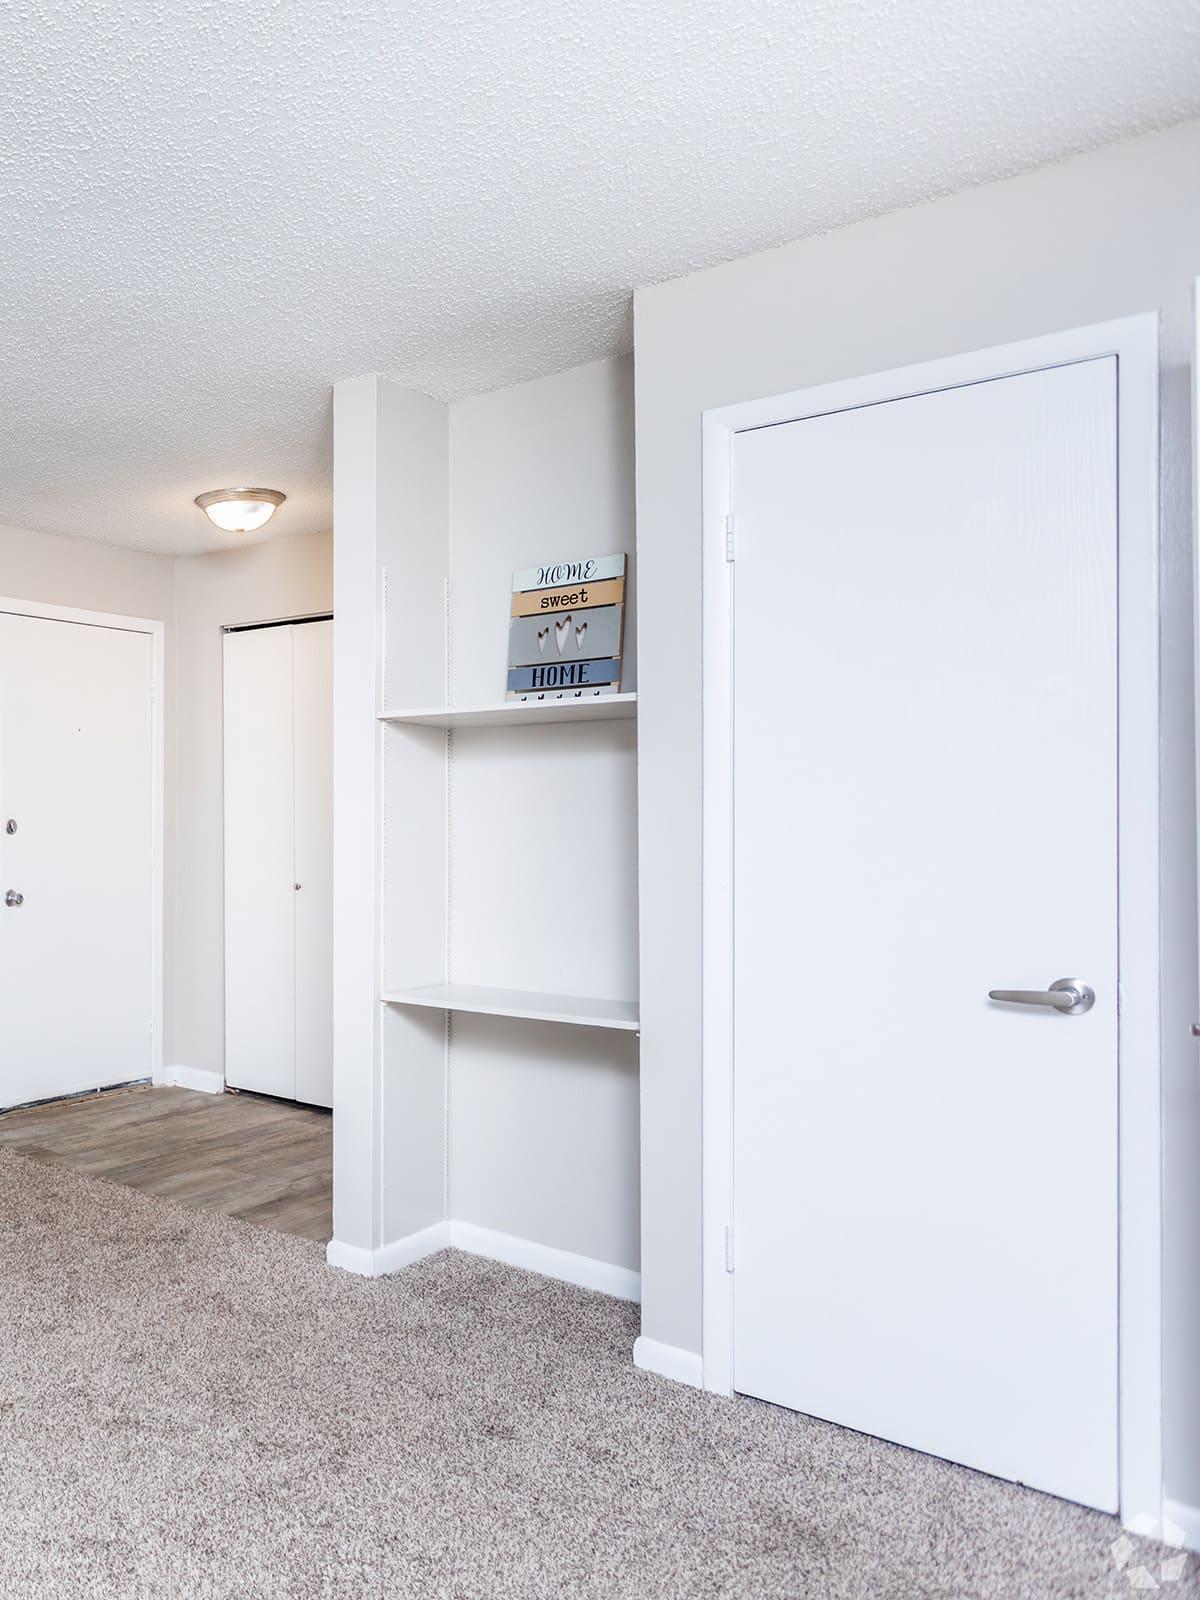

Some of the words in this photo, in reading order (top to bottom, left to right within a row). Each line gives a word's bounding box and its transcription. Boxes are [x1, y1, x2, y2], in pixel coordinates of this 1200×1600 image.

[537, 559, 598, 586] HOME
[540, 588, 589, 609] sweet
[531, 663, 590, 688] HOME
